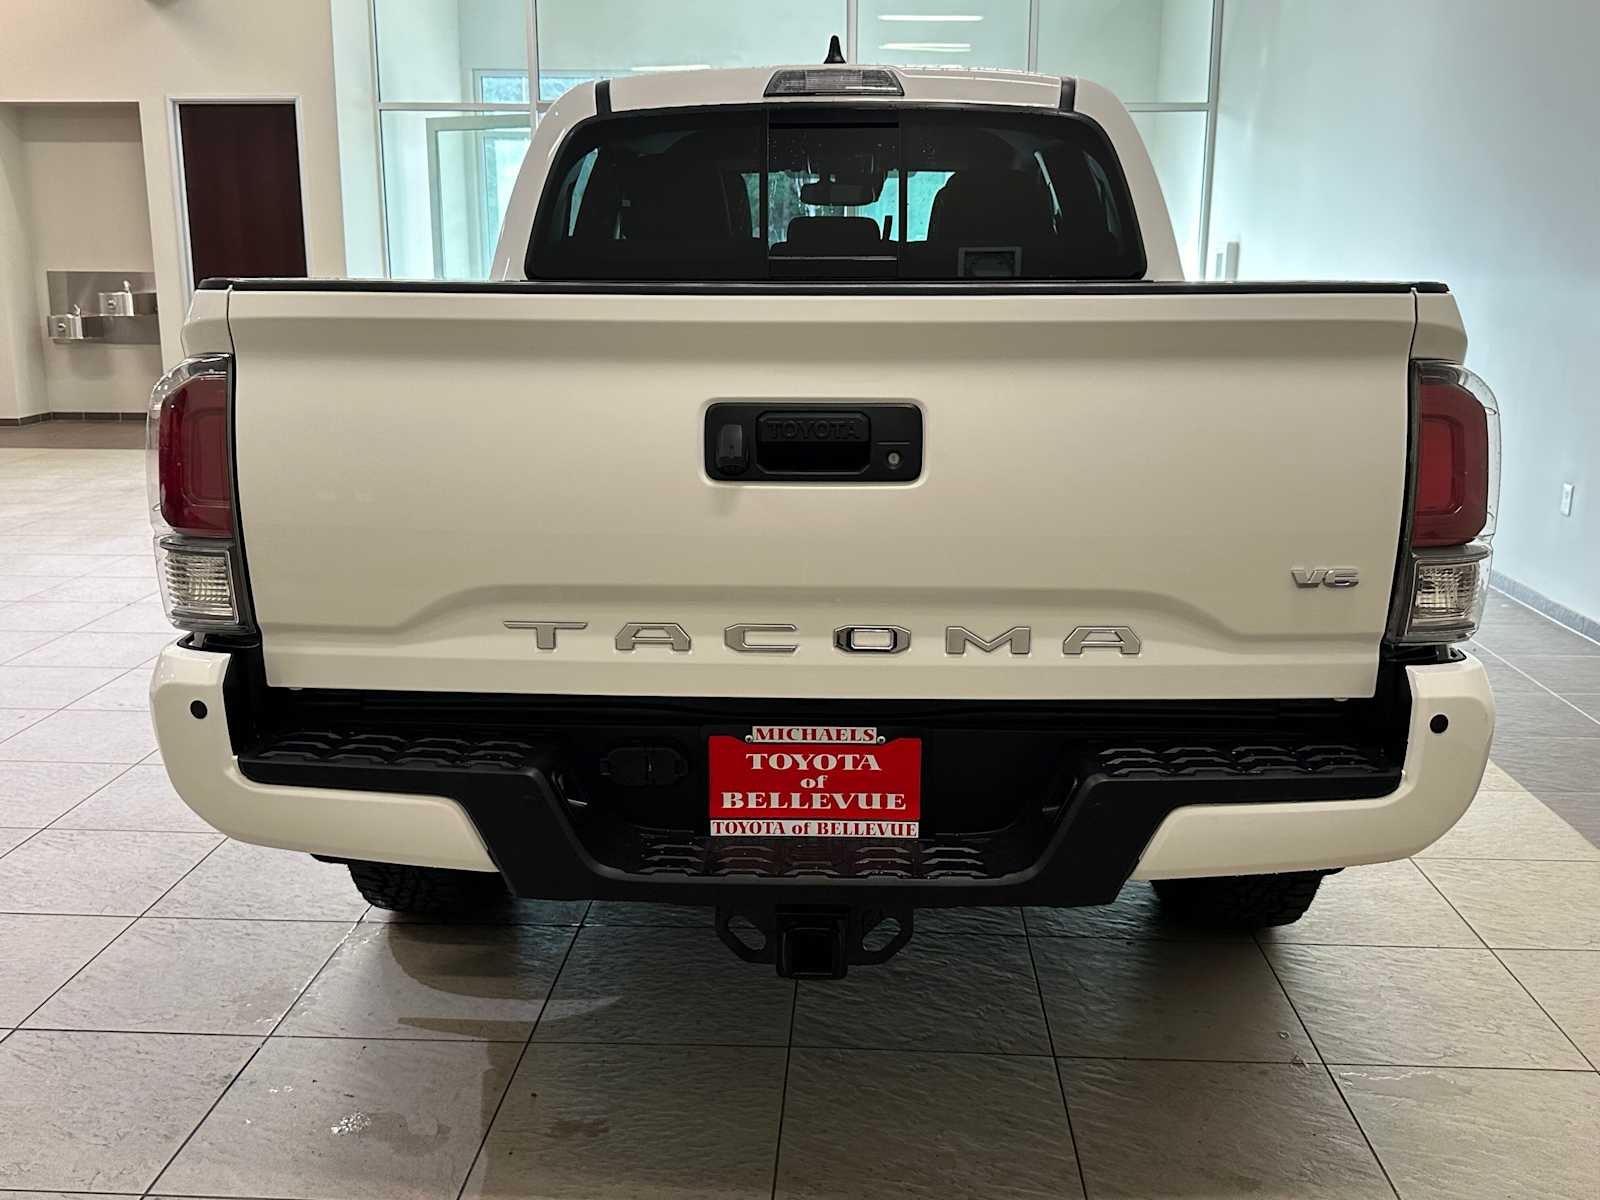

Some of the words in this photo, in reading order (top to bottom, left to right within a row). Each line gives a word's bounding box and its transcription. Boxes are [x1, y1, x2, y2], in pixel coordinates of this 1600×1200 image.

[767, 421, 861, 440] TOYOTA
[1291, 568, 1359, 588] V6
[503, 620, 1142, 656] TACOMA
[756, 727, 876, 742] MICHAELS
[746, 753, 881, 771] TOYOTA
[800, 775, 828, 789] of
[721, 792, 907, 810] BELLEVUE
[712, 821, 786, 835] TOYOTA
[791, 821, 812, 835] of
[817, 822, 917, 837] BELLEVUE
